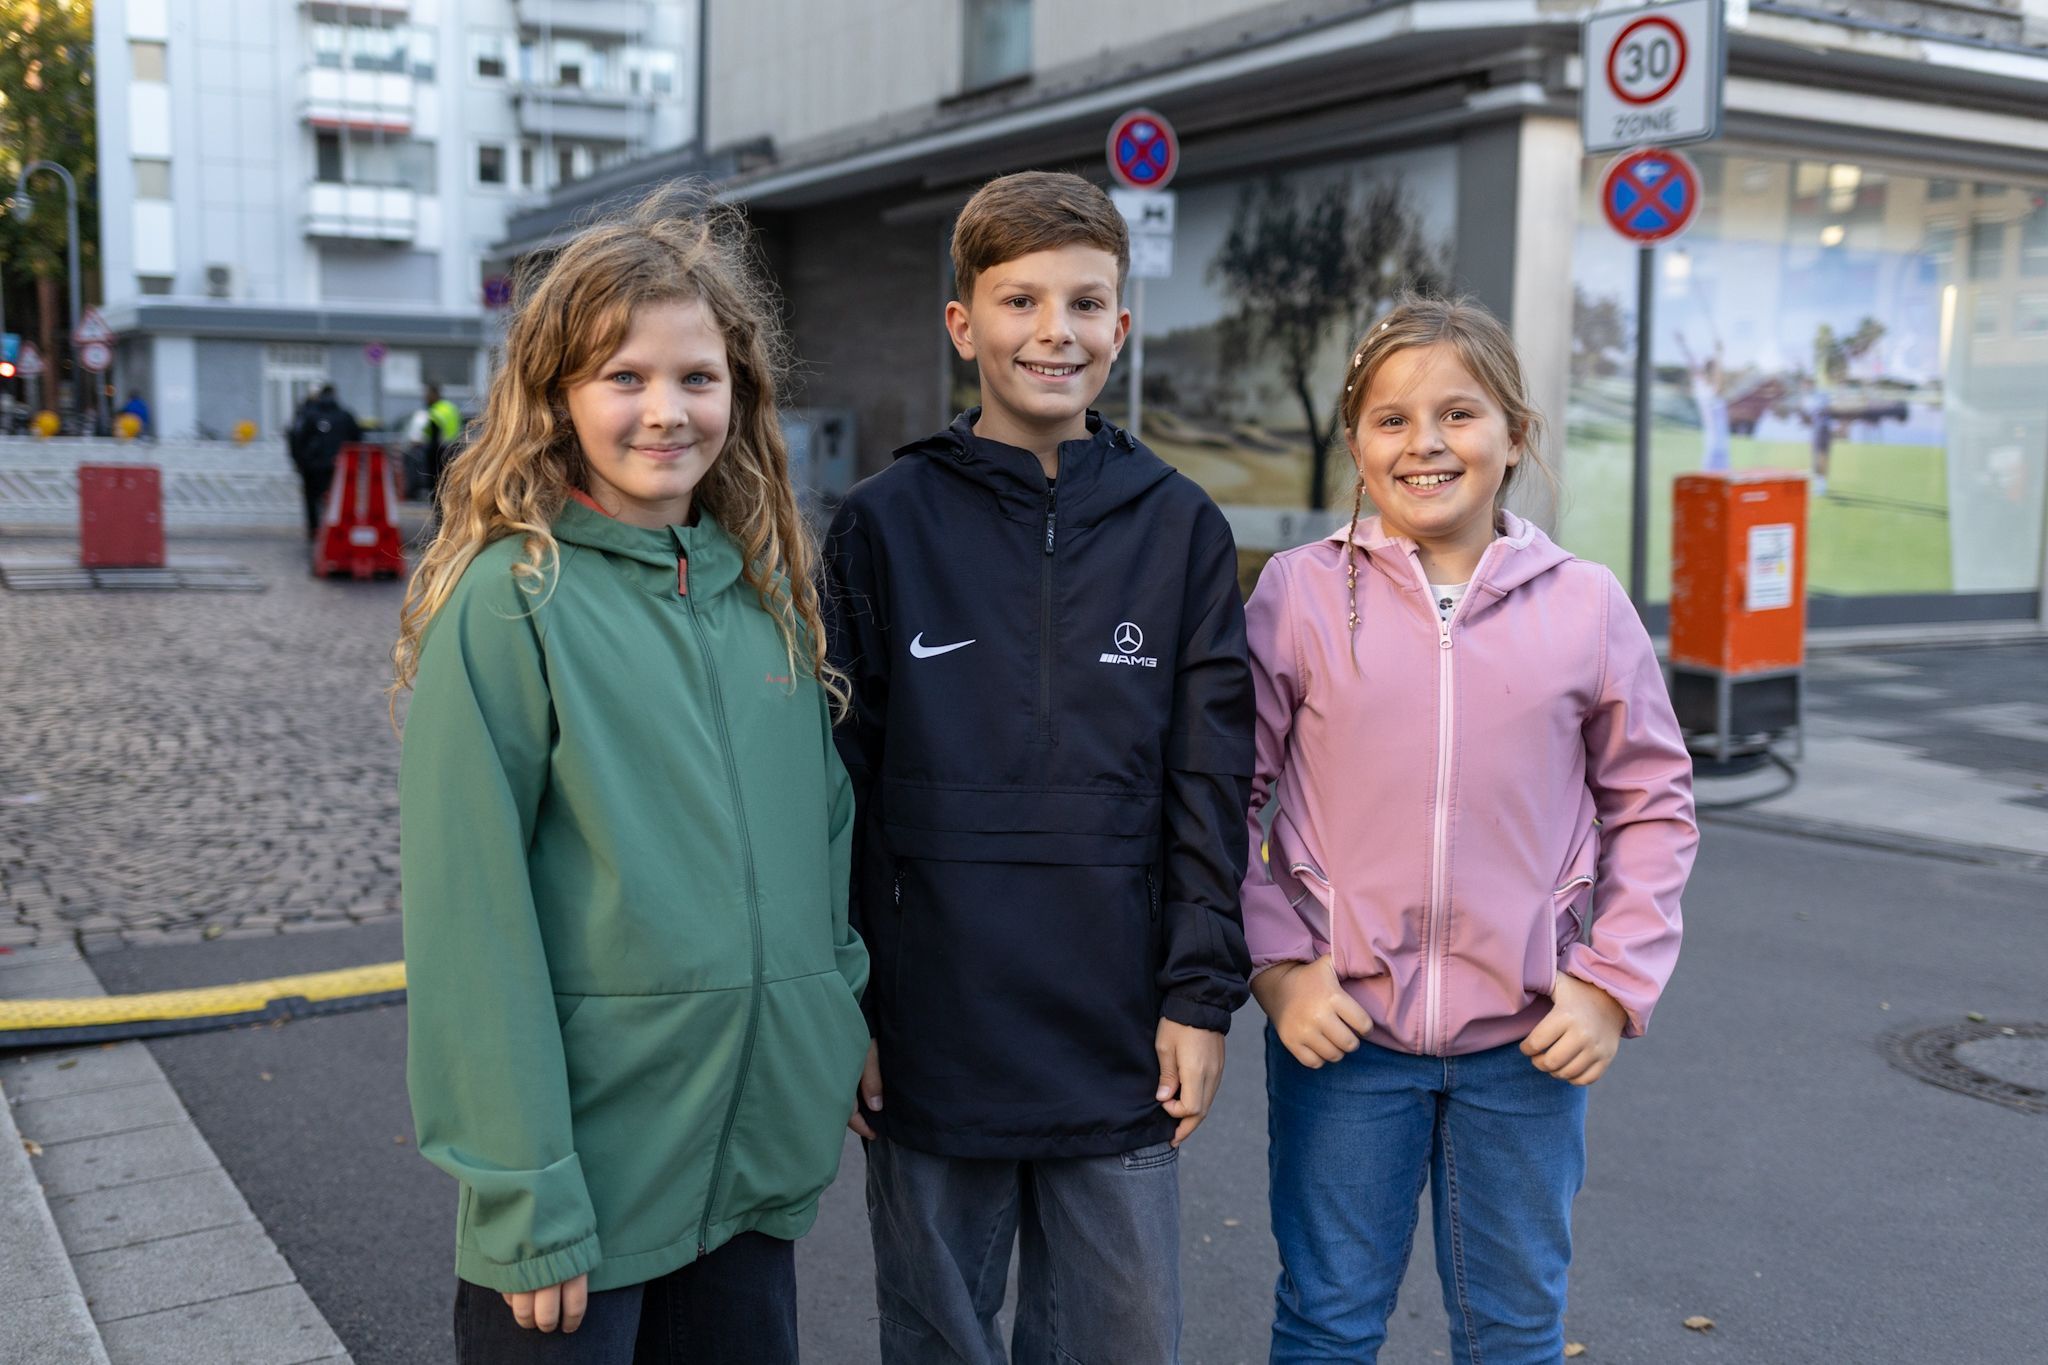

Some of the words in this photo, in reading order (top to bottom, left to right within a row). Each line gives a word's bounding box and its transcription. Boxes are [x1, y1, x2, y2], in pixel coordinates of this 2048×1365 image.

[1624, 38, 1670, 83] 30
[1613, 106, 1678, 137] ZONE
[1116, 654, 1157, 668] AMG
